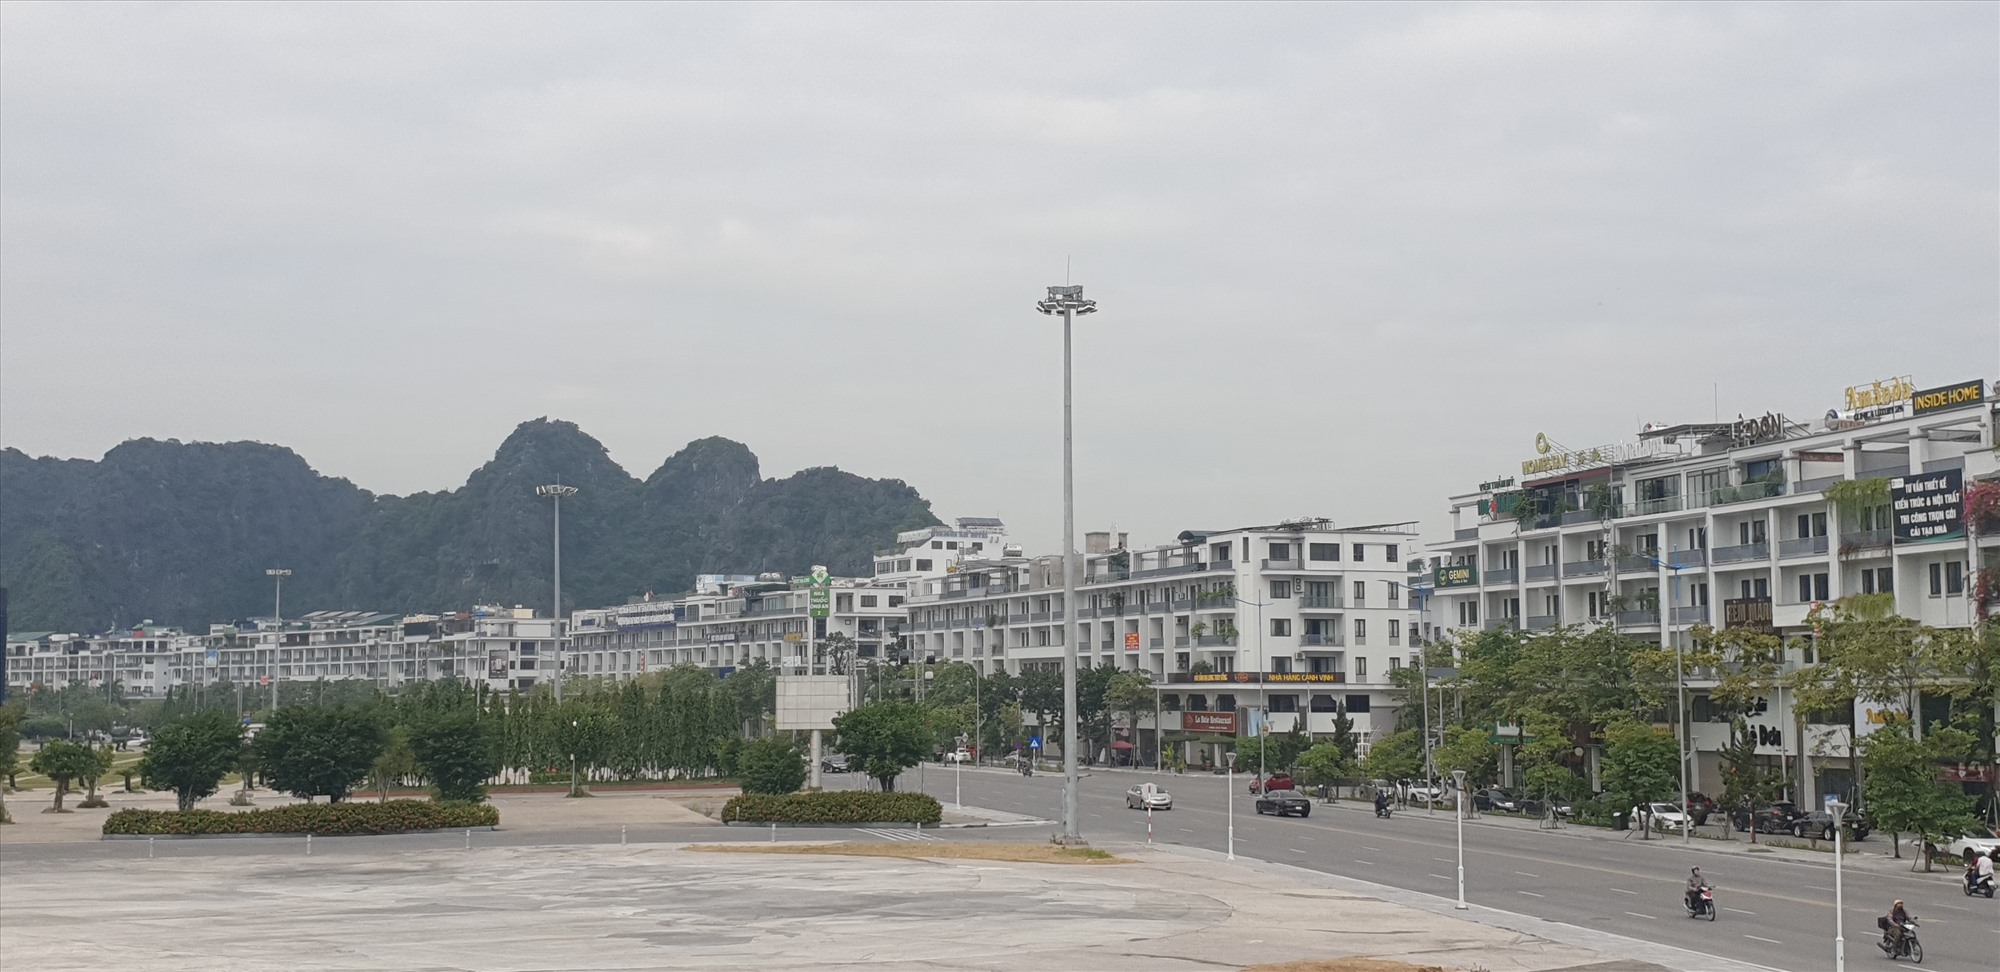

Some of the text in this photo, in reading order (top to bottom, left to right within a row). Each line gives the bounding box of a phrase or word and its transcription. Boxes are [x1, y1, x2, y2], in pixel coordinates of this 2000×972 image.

[1914, 385, 1980, 410] INSIDE HOME
[1522, 453, 1568, 475] HOMESTAY
[1905, 483, 1912, 493] TƯ
[1913, 480, 1923, 492] VẤN
[1924, 478, 1938, 491] THIẾT
[1939, 476, 1947, 489] KẾ
[1895, 497, 1908, 510] KIẾN
[1909, 496, 1925, 508] TRÚC
[1932, 493, 1943, 506] NỘI
[1944, 490, 1959, 504] THẤT
[1900, 507, 1956, 524] THI CÔNG TRỌN GÓI
[1910, 524, 1947, 537] CẢI TẠO NHÀ
[1449, 569, 1470, 580] GEMINI
[1268, 672, 1334, 682] NHÀ HÀNG CẢNH VỊNH
[1210, 715, 1232, 725] Restaurant
